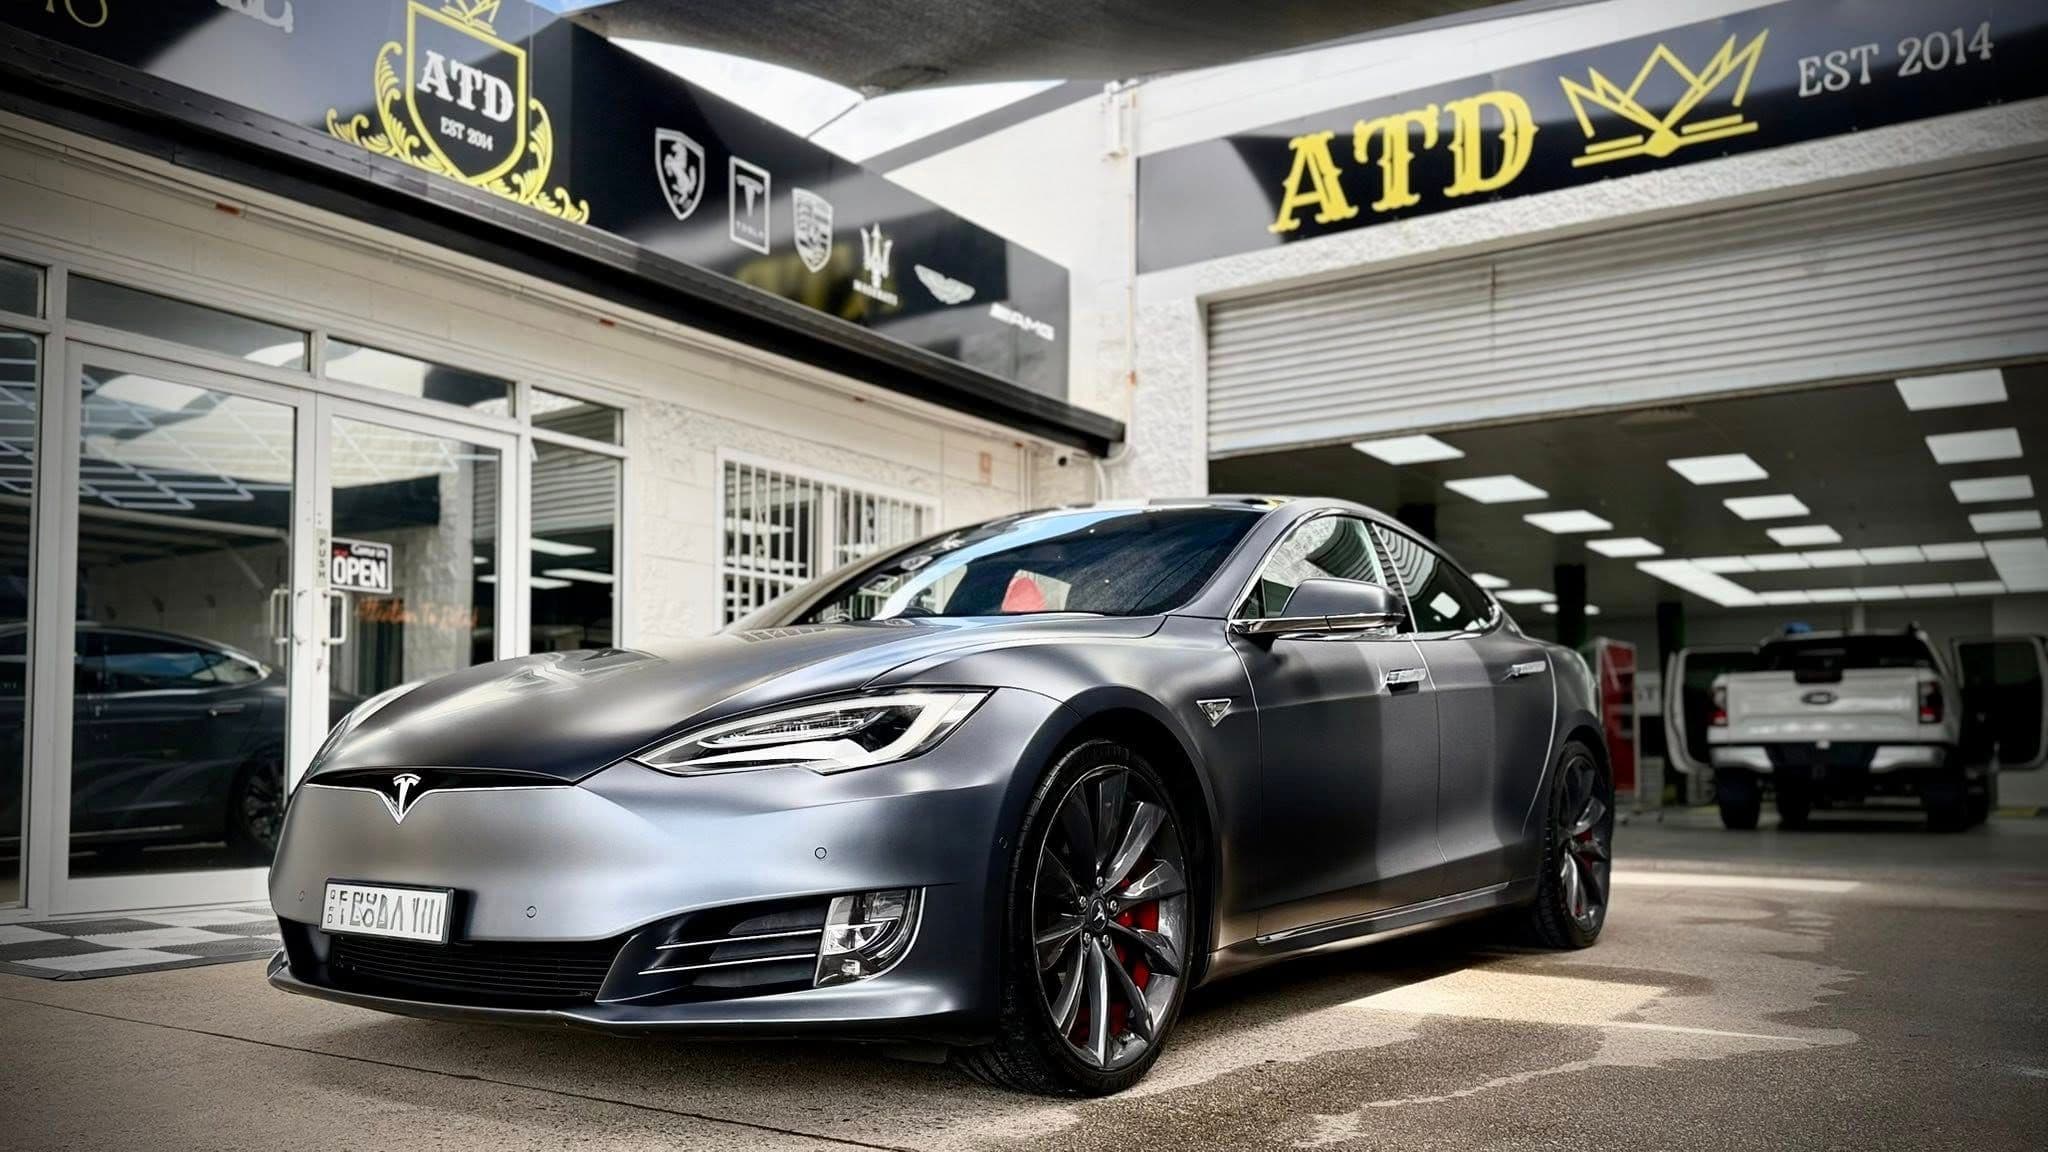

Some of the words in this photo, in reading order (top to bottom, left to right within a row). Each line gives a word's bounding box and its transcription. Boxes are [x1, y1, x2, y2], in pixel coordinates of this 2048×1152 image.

[416, 49, 514, 122] ATD
[440, 115, 465, 140] EST
[466, 127, 494, 151] 2014
[1267, 90, 1539, 233] ATD
[1797, 43, 1879, 97] EST
[1897, 21, 1994, 77] 2014
[319, 537, 327, 579] PUSH
[333, 556, 386, 588] OPEN
